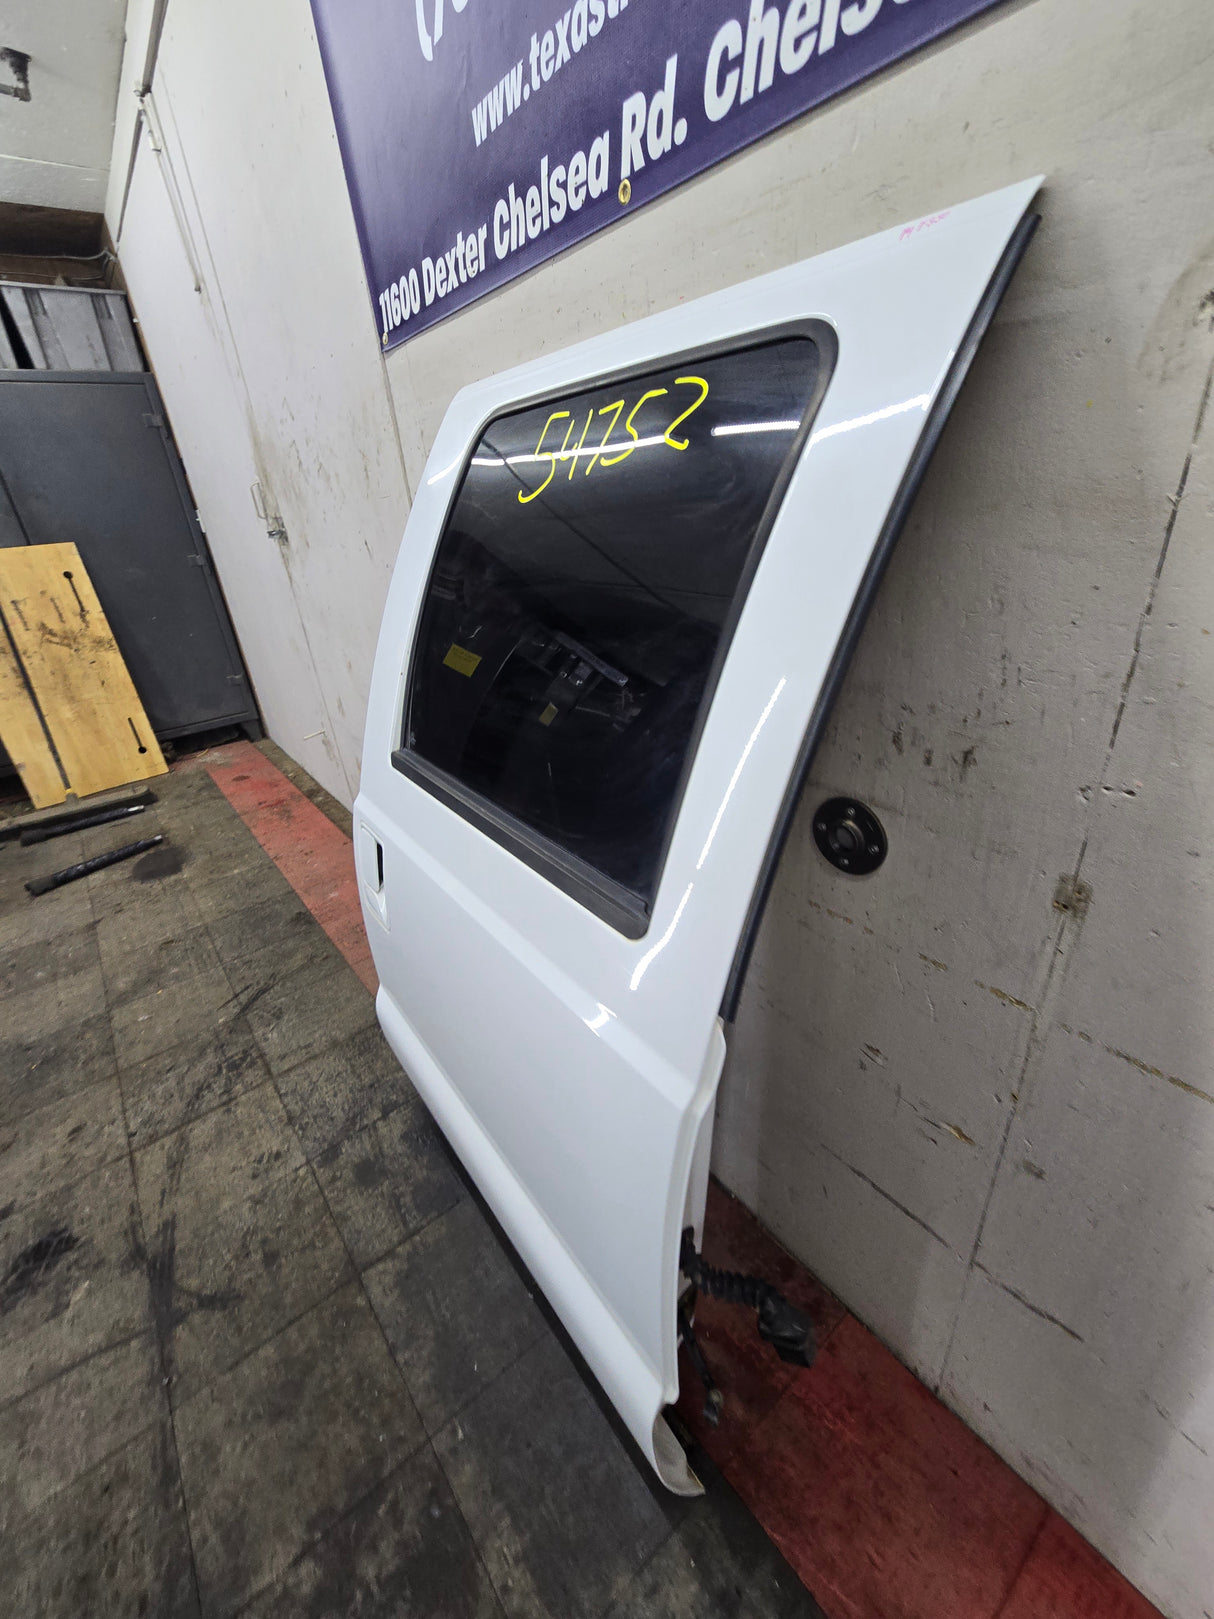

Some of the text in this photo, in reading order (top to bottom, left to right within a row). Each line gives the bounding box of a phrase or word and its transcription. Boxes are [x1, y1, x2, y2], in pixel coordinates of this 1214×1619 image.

[378, 0, 911, 333] 11600 Dexter Chelsea Rd. Che
[471, 0, 629, 147] www.texas
